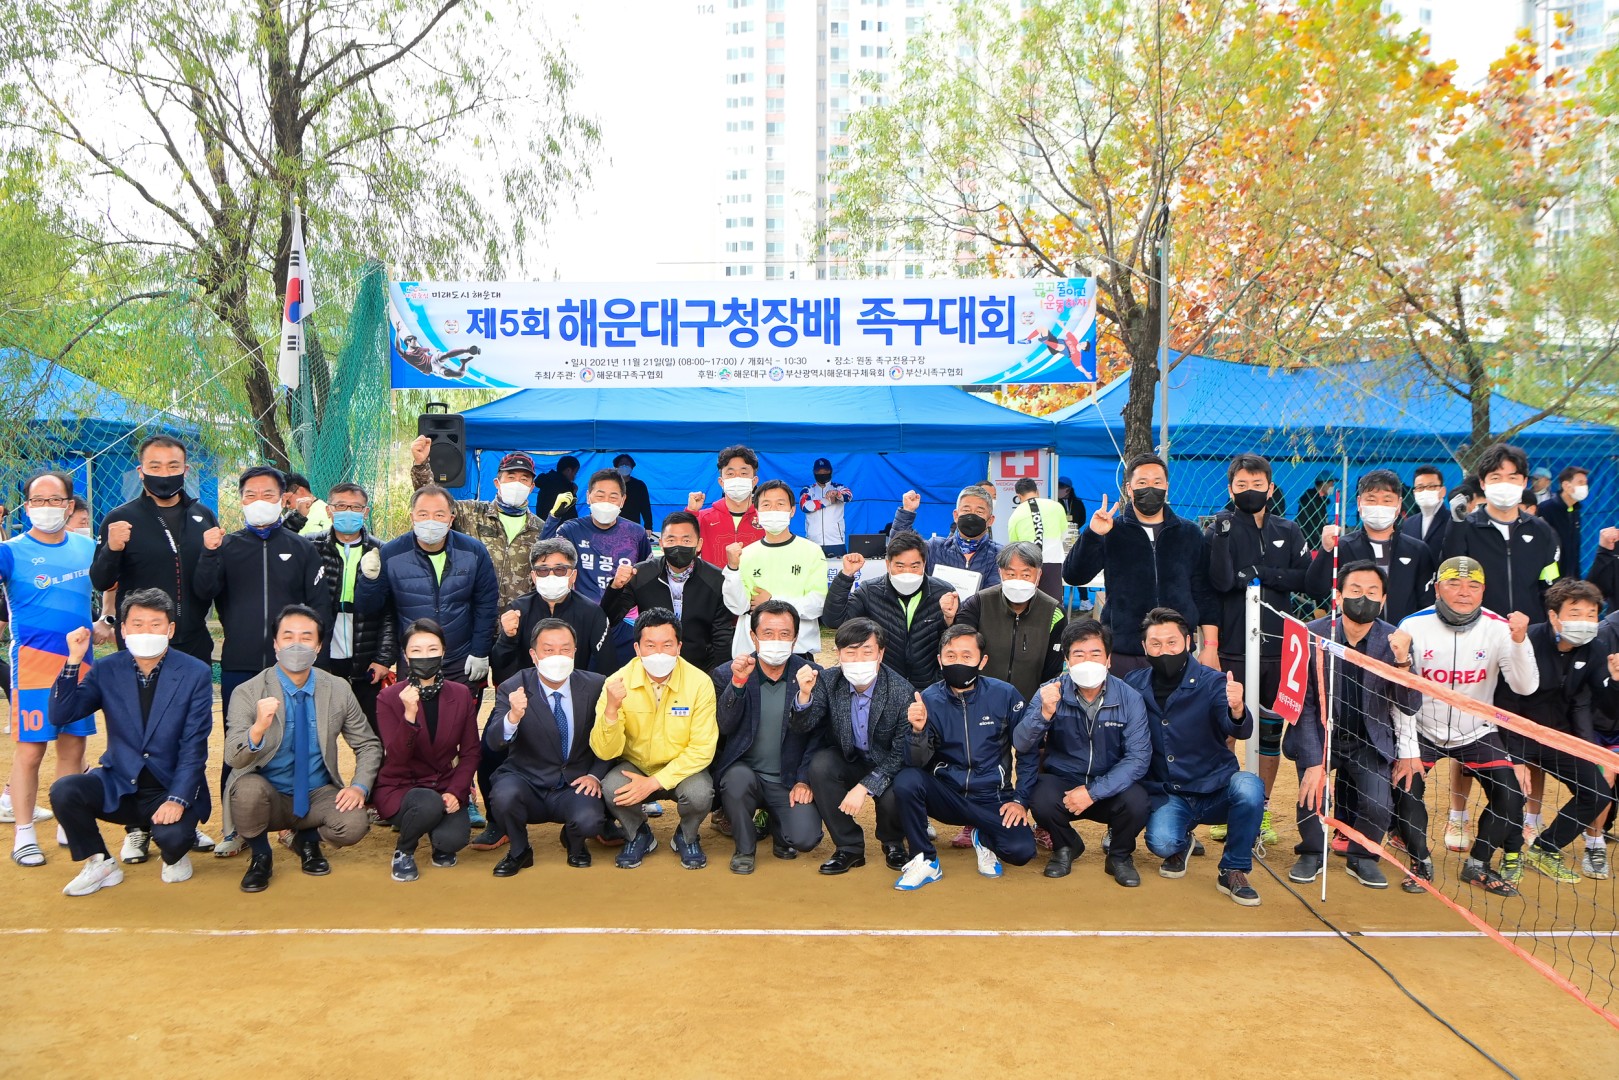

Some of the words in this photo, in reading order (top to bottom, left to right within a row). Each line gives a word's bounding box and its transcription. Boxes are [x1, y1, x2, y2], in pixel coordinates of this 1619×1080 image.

[697, 4, 714, 15] 114
[431, 291, 470, 300] 미래도시
[472, 291, 502, 299] 해운대
[466, 307, 550, 340] 제5회
[557, 297, 841, 349] 해운대구청장배
[857, 295, 1016, 346] 족구대회
[570, 358, 587, 368] 일시
[590, 358, 619, 368] 2021년
[622, 358, 640, 367] 11월
[643, 357, 676, 368] 21일(일)
[678, 357, 738, 367] (08:00~17:00)
[748, 356, 773, 367] 개회식
[784, 356, 807, 366] 10:30
[834, 356, 855, 367] 장소:
[856, 356, 873, 367] 원동
[876, 355, 926, 367] 족구전용구장
[534, 371, 577, 381] 주최/주관:
[596, 370, 664, 380] 해운대구족구협회
[698, 370, 717, 380] 후원:
[733, 369, 767, 379] 해운대구
[786, 368, 886, 379] 부산광역시해운대구체육회
[906, 367, 964, 378] 부산시족구협회
[1286, 633, 1303, 693] 2
[1421, 667, 1487, 685] KOREA
[21, 709, 43, 732] 10
